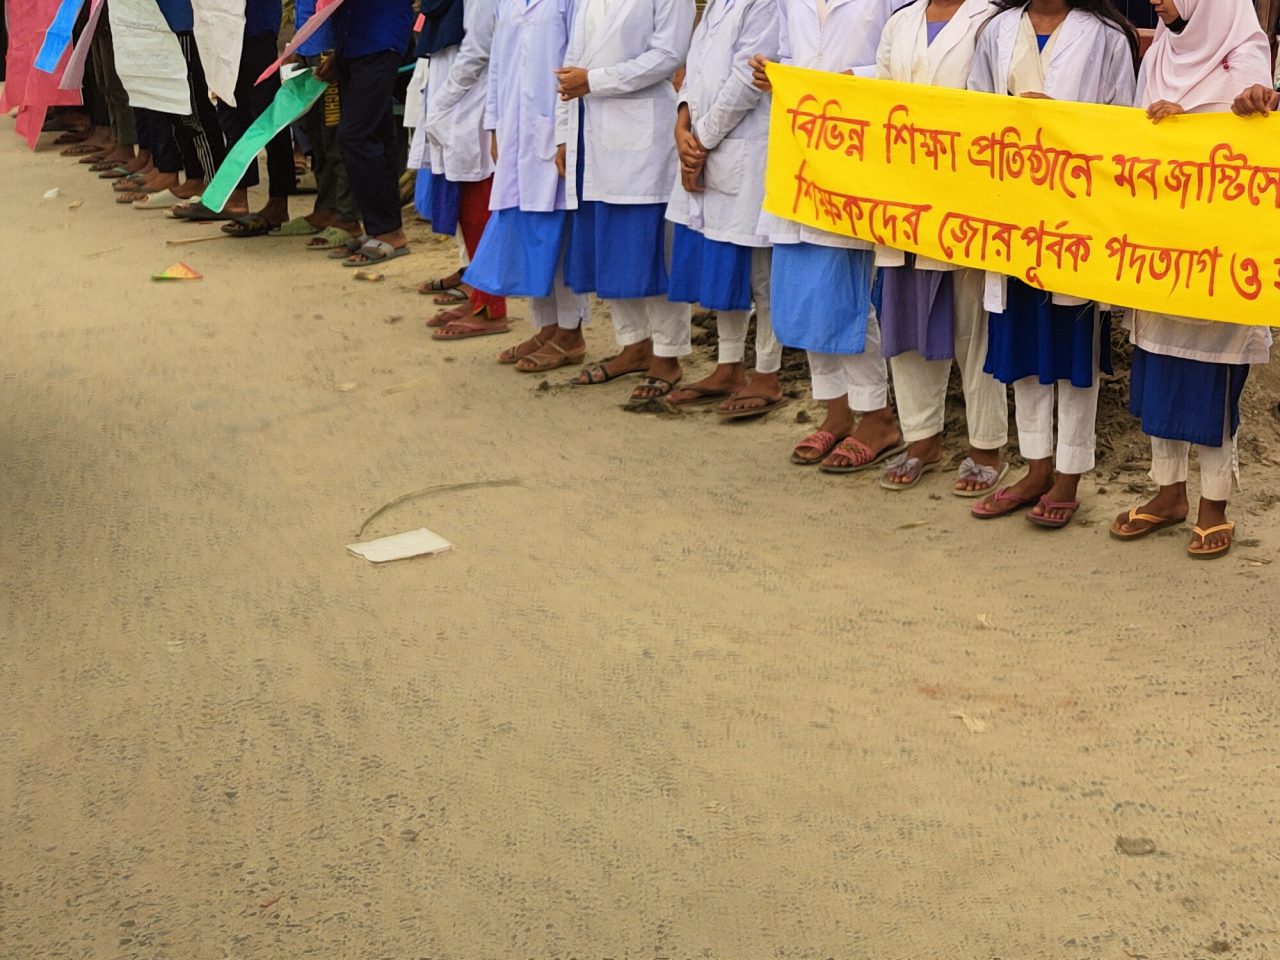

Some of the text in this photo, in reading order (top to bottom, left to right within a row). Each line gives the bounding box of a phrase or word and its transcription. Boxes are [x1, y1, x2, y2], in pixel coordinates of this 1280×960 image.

[786, 94, 870, 161] বিভিন্ন
[882, 104, 961, 172] শিক্ষা
[967, 125, 1103, 198] প্রতিষ্ঠানে
[792, 159, 933, 248] শিক্ষকদের
[1105, 233, 1223, 298] পদত্যাগ
[1229, 252, 1263, 301] ও
